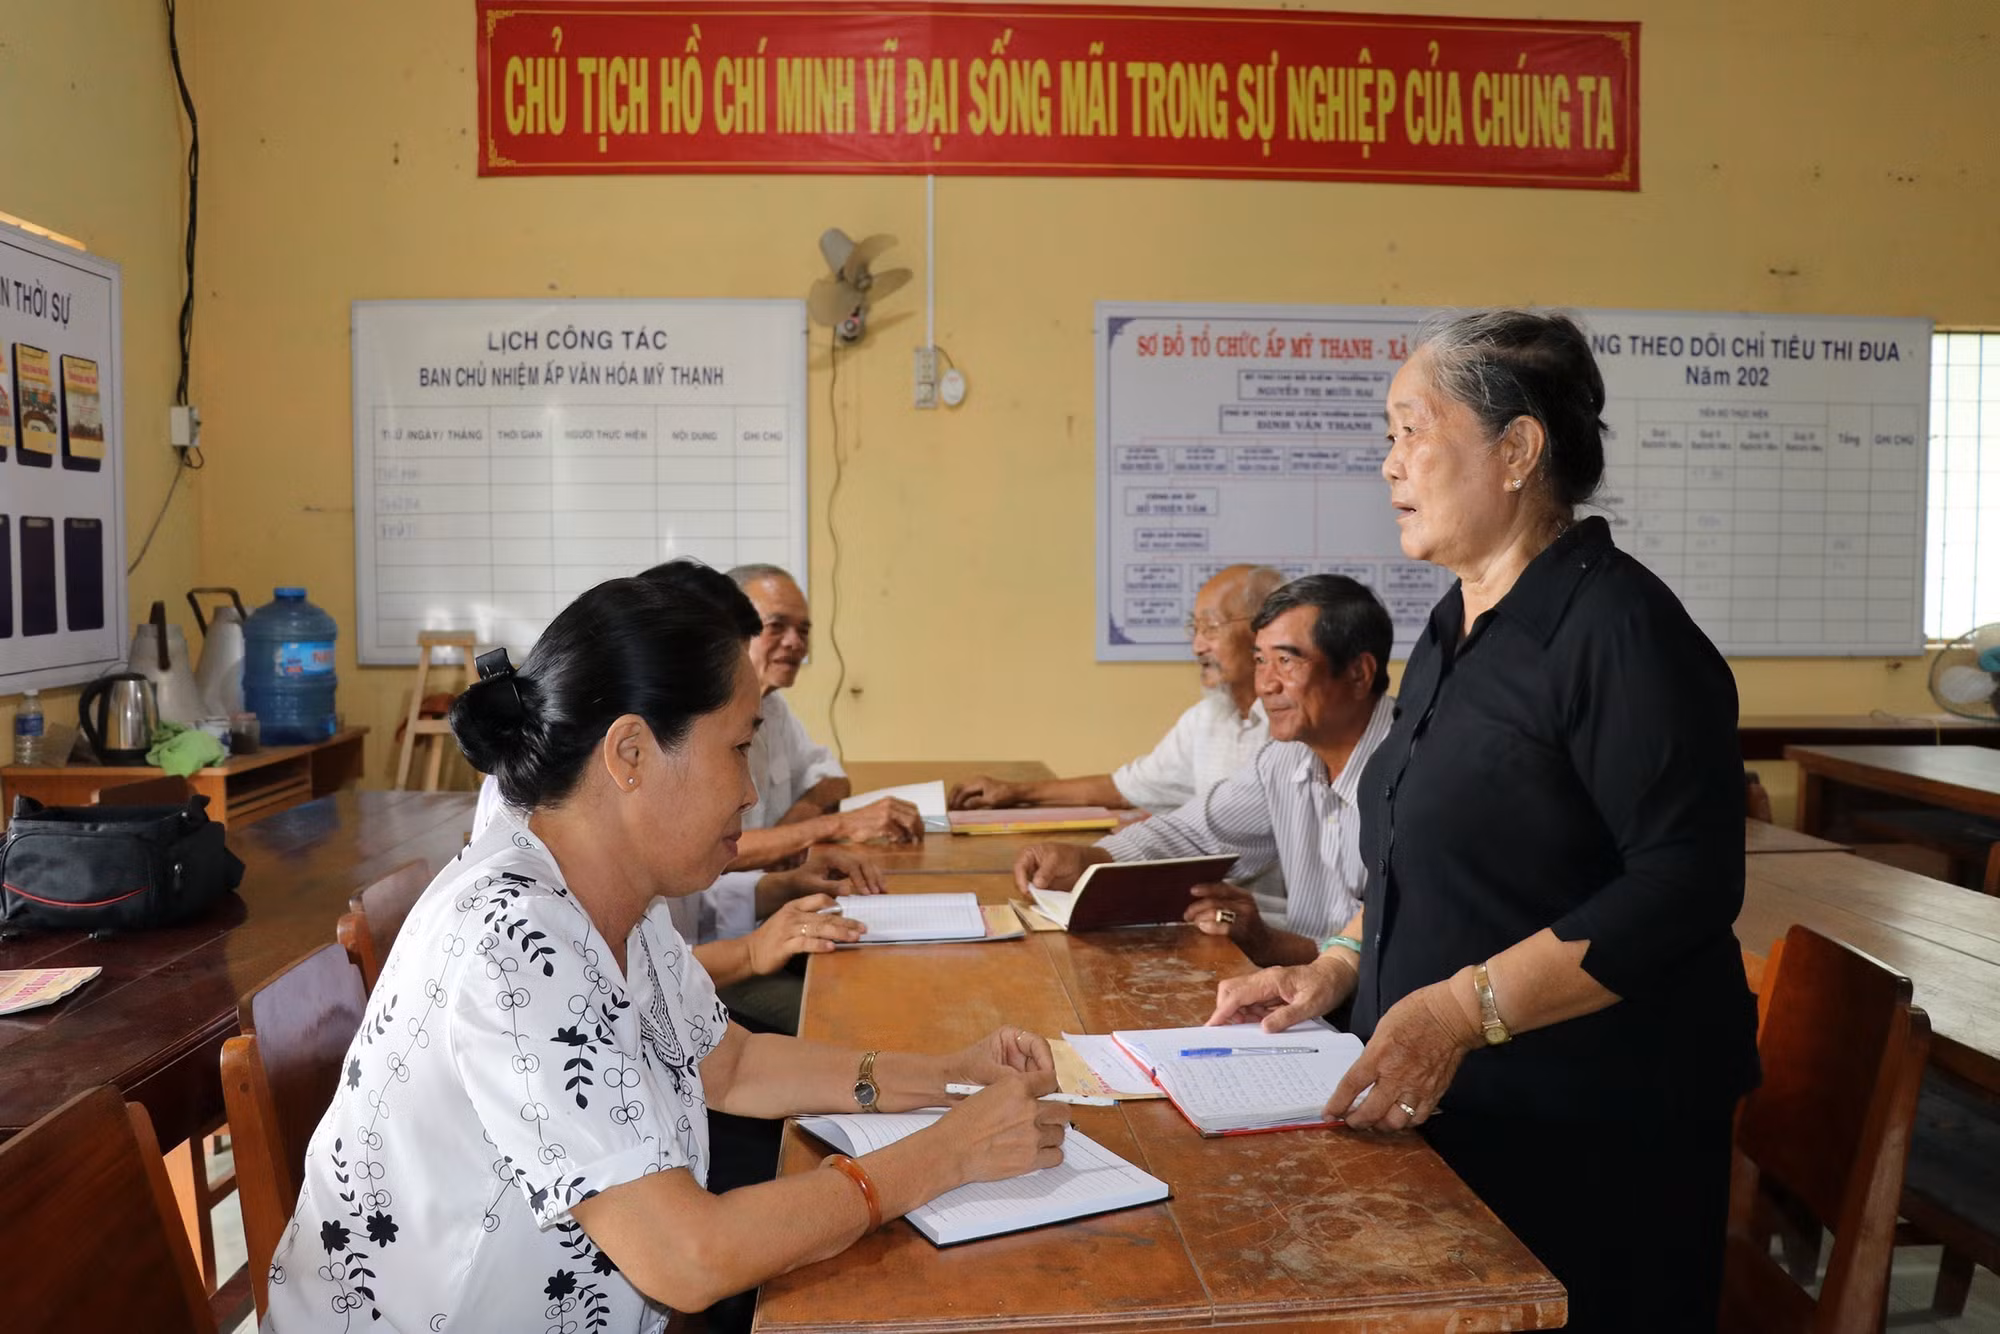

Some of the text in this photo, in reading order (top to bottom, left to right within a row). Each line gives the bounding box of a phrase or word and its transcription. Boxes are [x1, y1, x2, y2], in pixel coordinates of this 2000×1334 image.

[505, 23, 1616, 158] CHỦ TỊCH HỒ CHÍ MINH VĨ ĐẠI SỐNG MÃI TRONG SỰ NGHIỆP CỦA CHÚNG TA
[14, 278, 47, 319] THỜI
[52, 292, 72, 330] SỰ
[488, 325, 668, 354] LỊCH CÔNG TÁC
[1137, 333, 1158, 356] SƠ
[1162, 324, 1184, 357] ĐỒ
[1191, 324, 1210, 357] TỔ
[1216, 331, 1261, 358] CHỨC
[1265, 328, 1286, 358] ẤP
[1291, 332, 1313, 359] MỸ
[1320, 338, 1373, 364] THẠNH
[1591, 331, 1900, 361] NG THEO DÕI CHỈ TIÊU THI ĐUA
[420, 359, 724, 390] BAN CHỦ NHIỆM ẤP VĂN HÓA MỸ THẠNH
[1686, 366, 1769, 386] Năm 202
